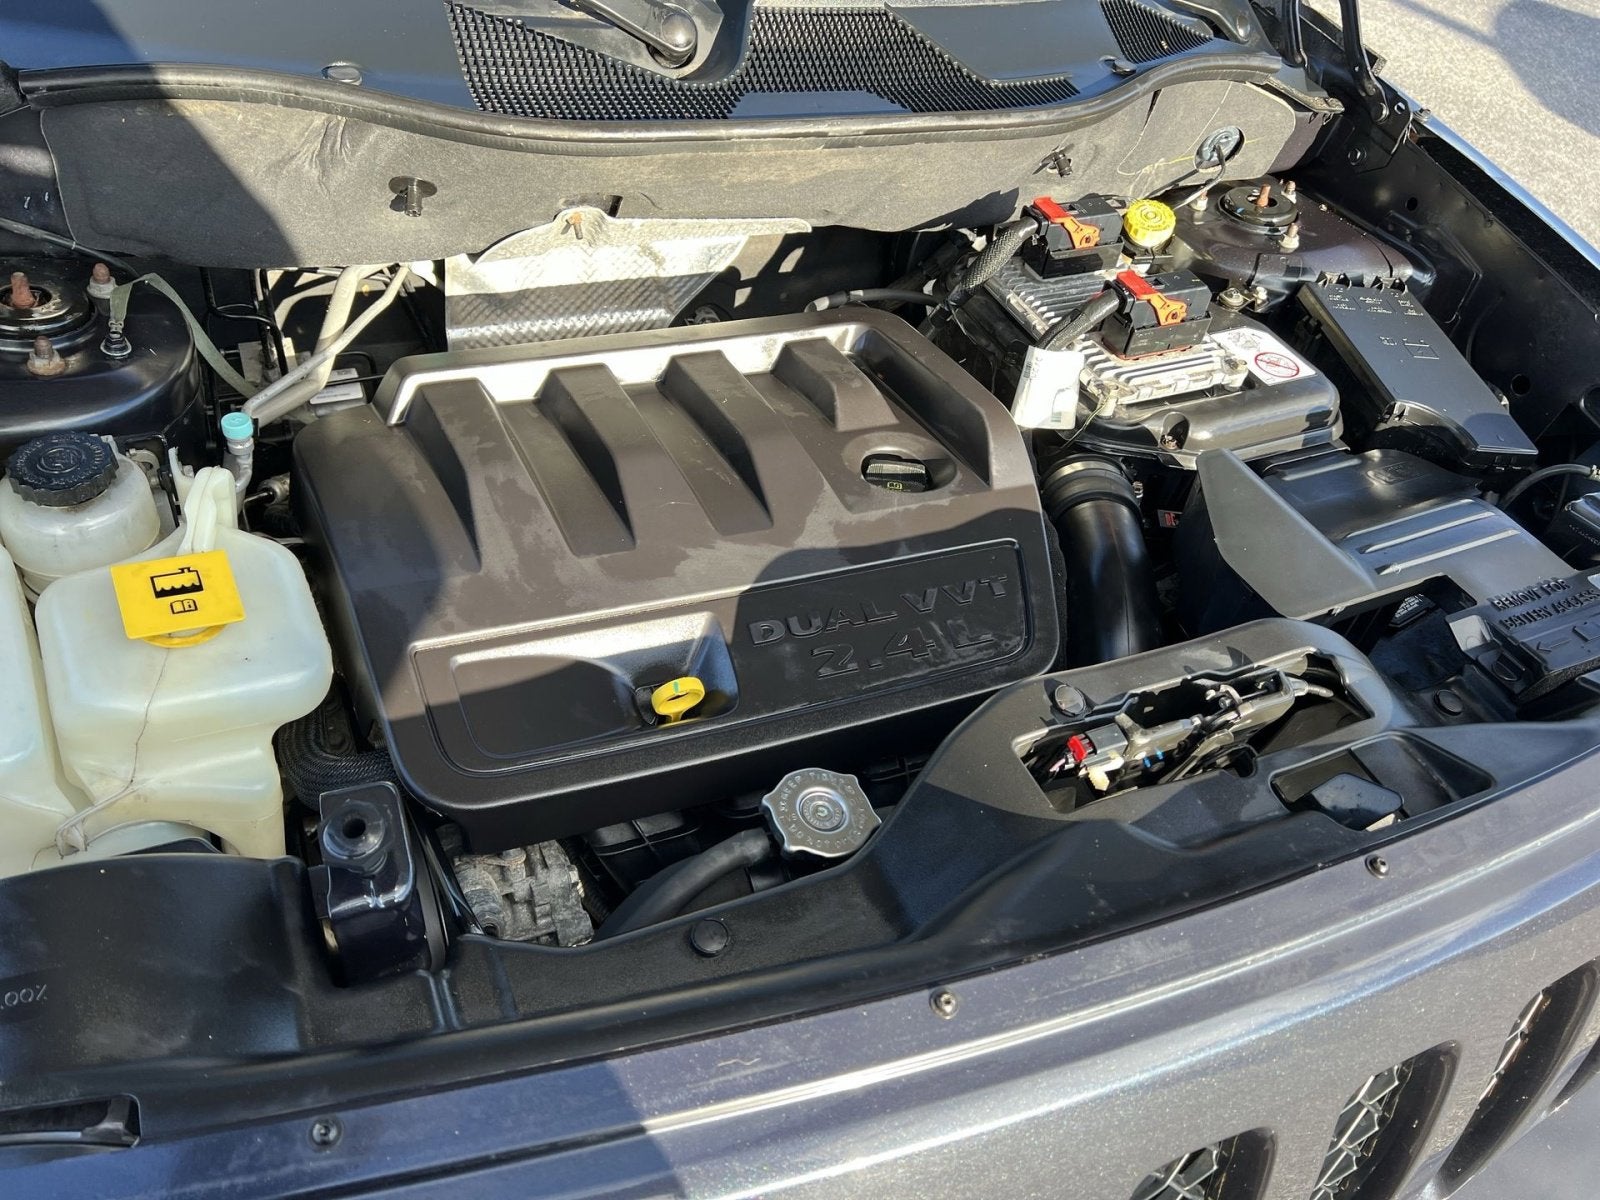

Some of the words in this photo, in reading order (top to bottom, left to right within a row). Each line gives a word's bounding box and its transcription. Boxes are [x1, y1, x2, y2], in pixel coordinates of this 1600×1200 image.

[749, 601, 898, 646] DUAL
[901, 575, 1008, 613] VVT
[1490, 586, 1542, 611] REMOVE
[1541, 578, 1571, 596] FOR
[1500, 604, 1553, 630] BATTERY
[811, 620, 995, 680] 2.4L
